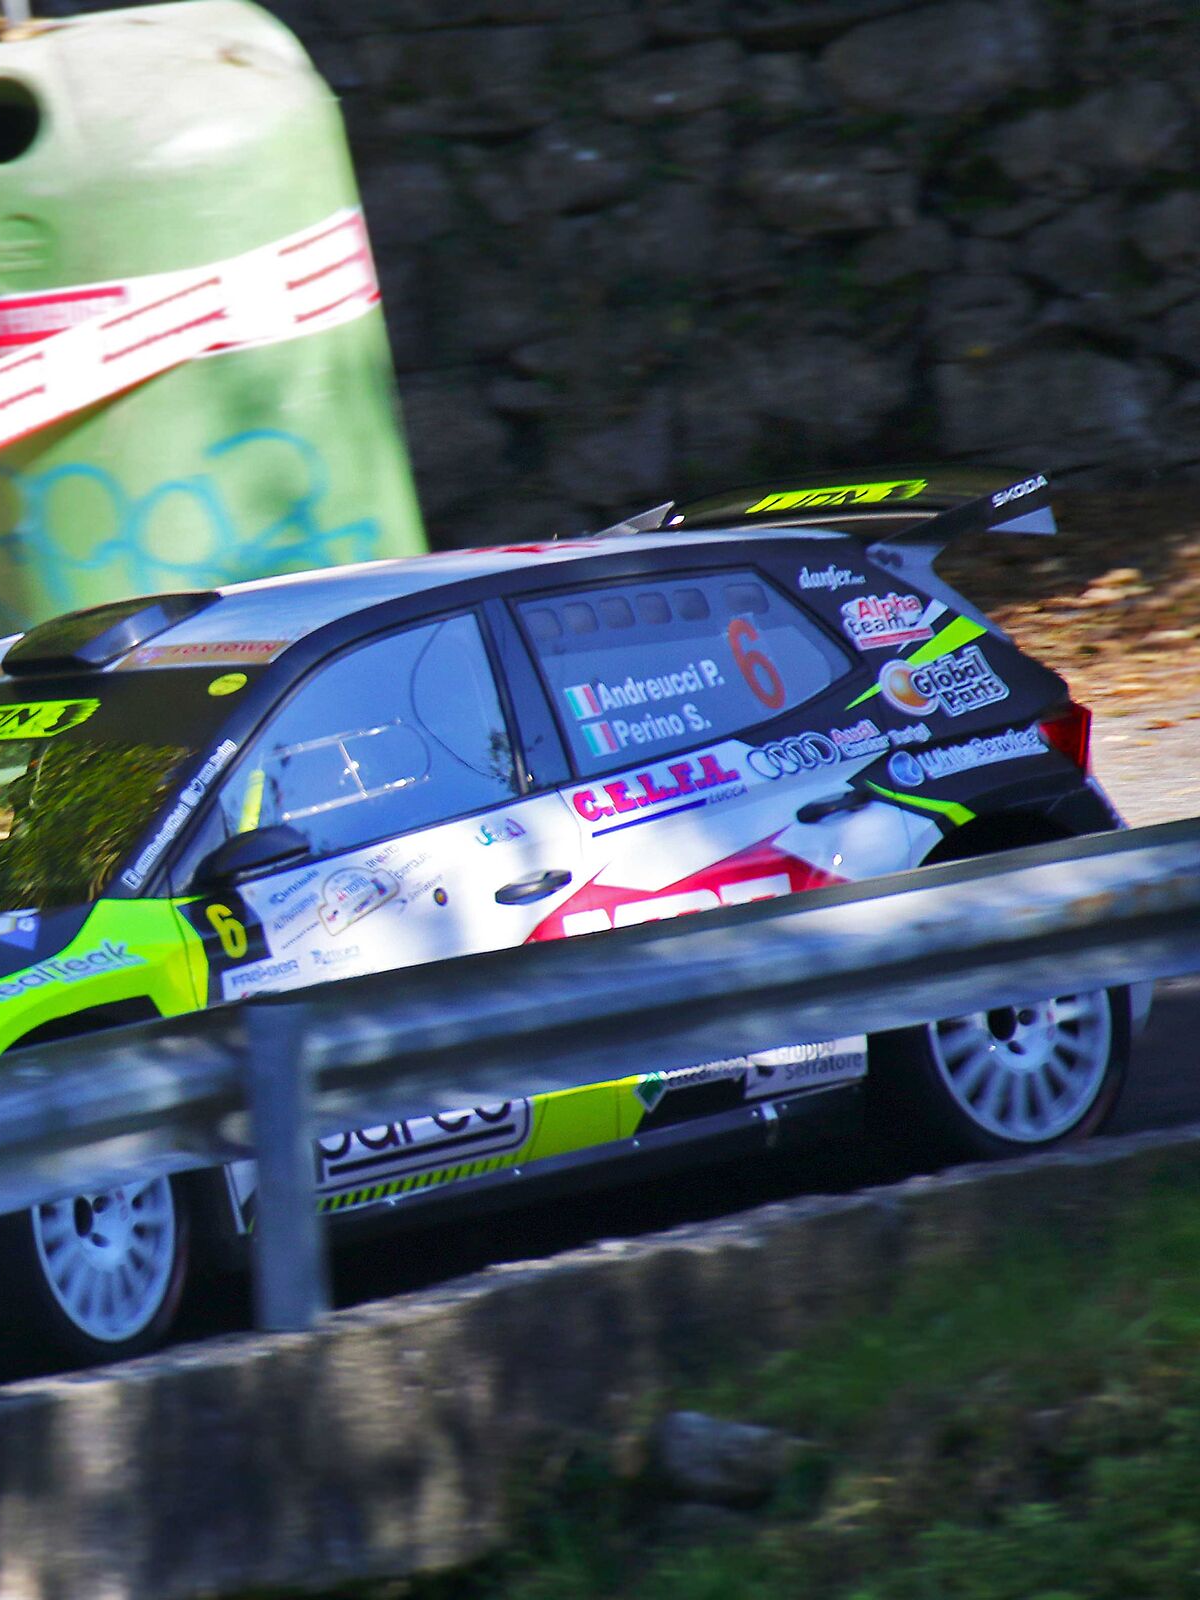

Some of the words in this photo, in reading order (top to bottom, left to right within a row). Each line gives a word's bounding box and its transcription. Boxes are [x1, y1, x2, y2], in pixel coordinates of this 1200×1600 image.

[991, 474, 1048, 508] SKODA
[858, 593, 922, 621] Alpha
[597, 662, 704, 711] Andreucci
[699, 658, 726, 689] P.
[727, 617, 786, 710] 6
[911, 648, 988, 695] Global
[941, 677, 1003, 712] Parts
[611, 713, 687, 748] Perino
[682, 702, 713, 732] S.
[206, 903, 247, 958] 6
